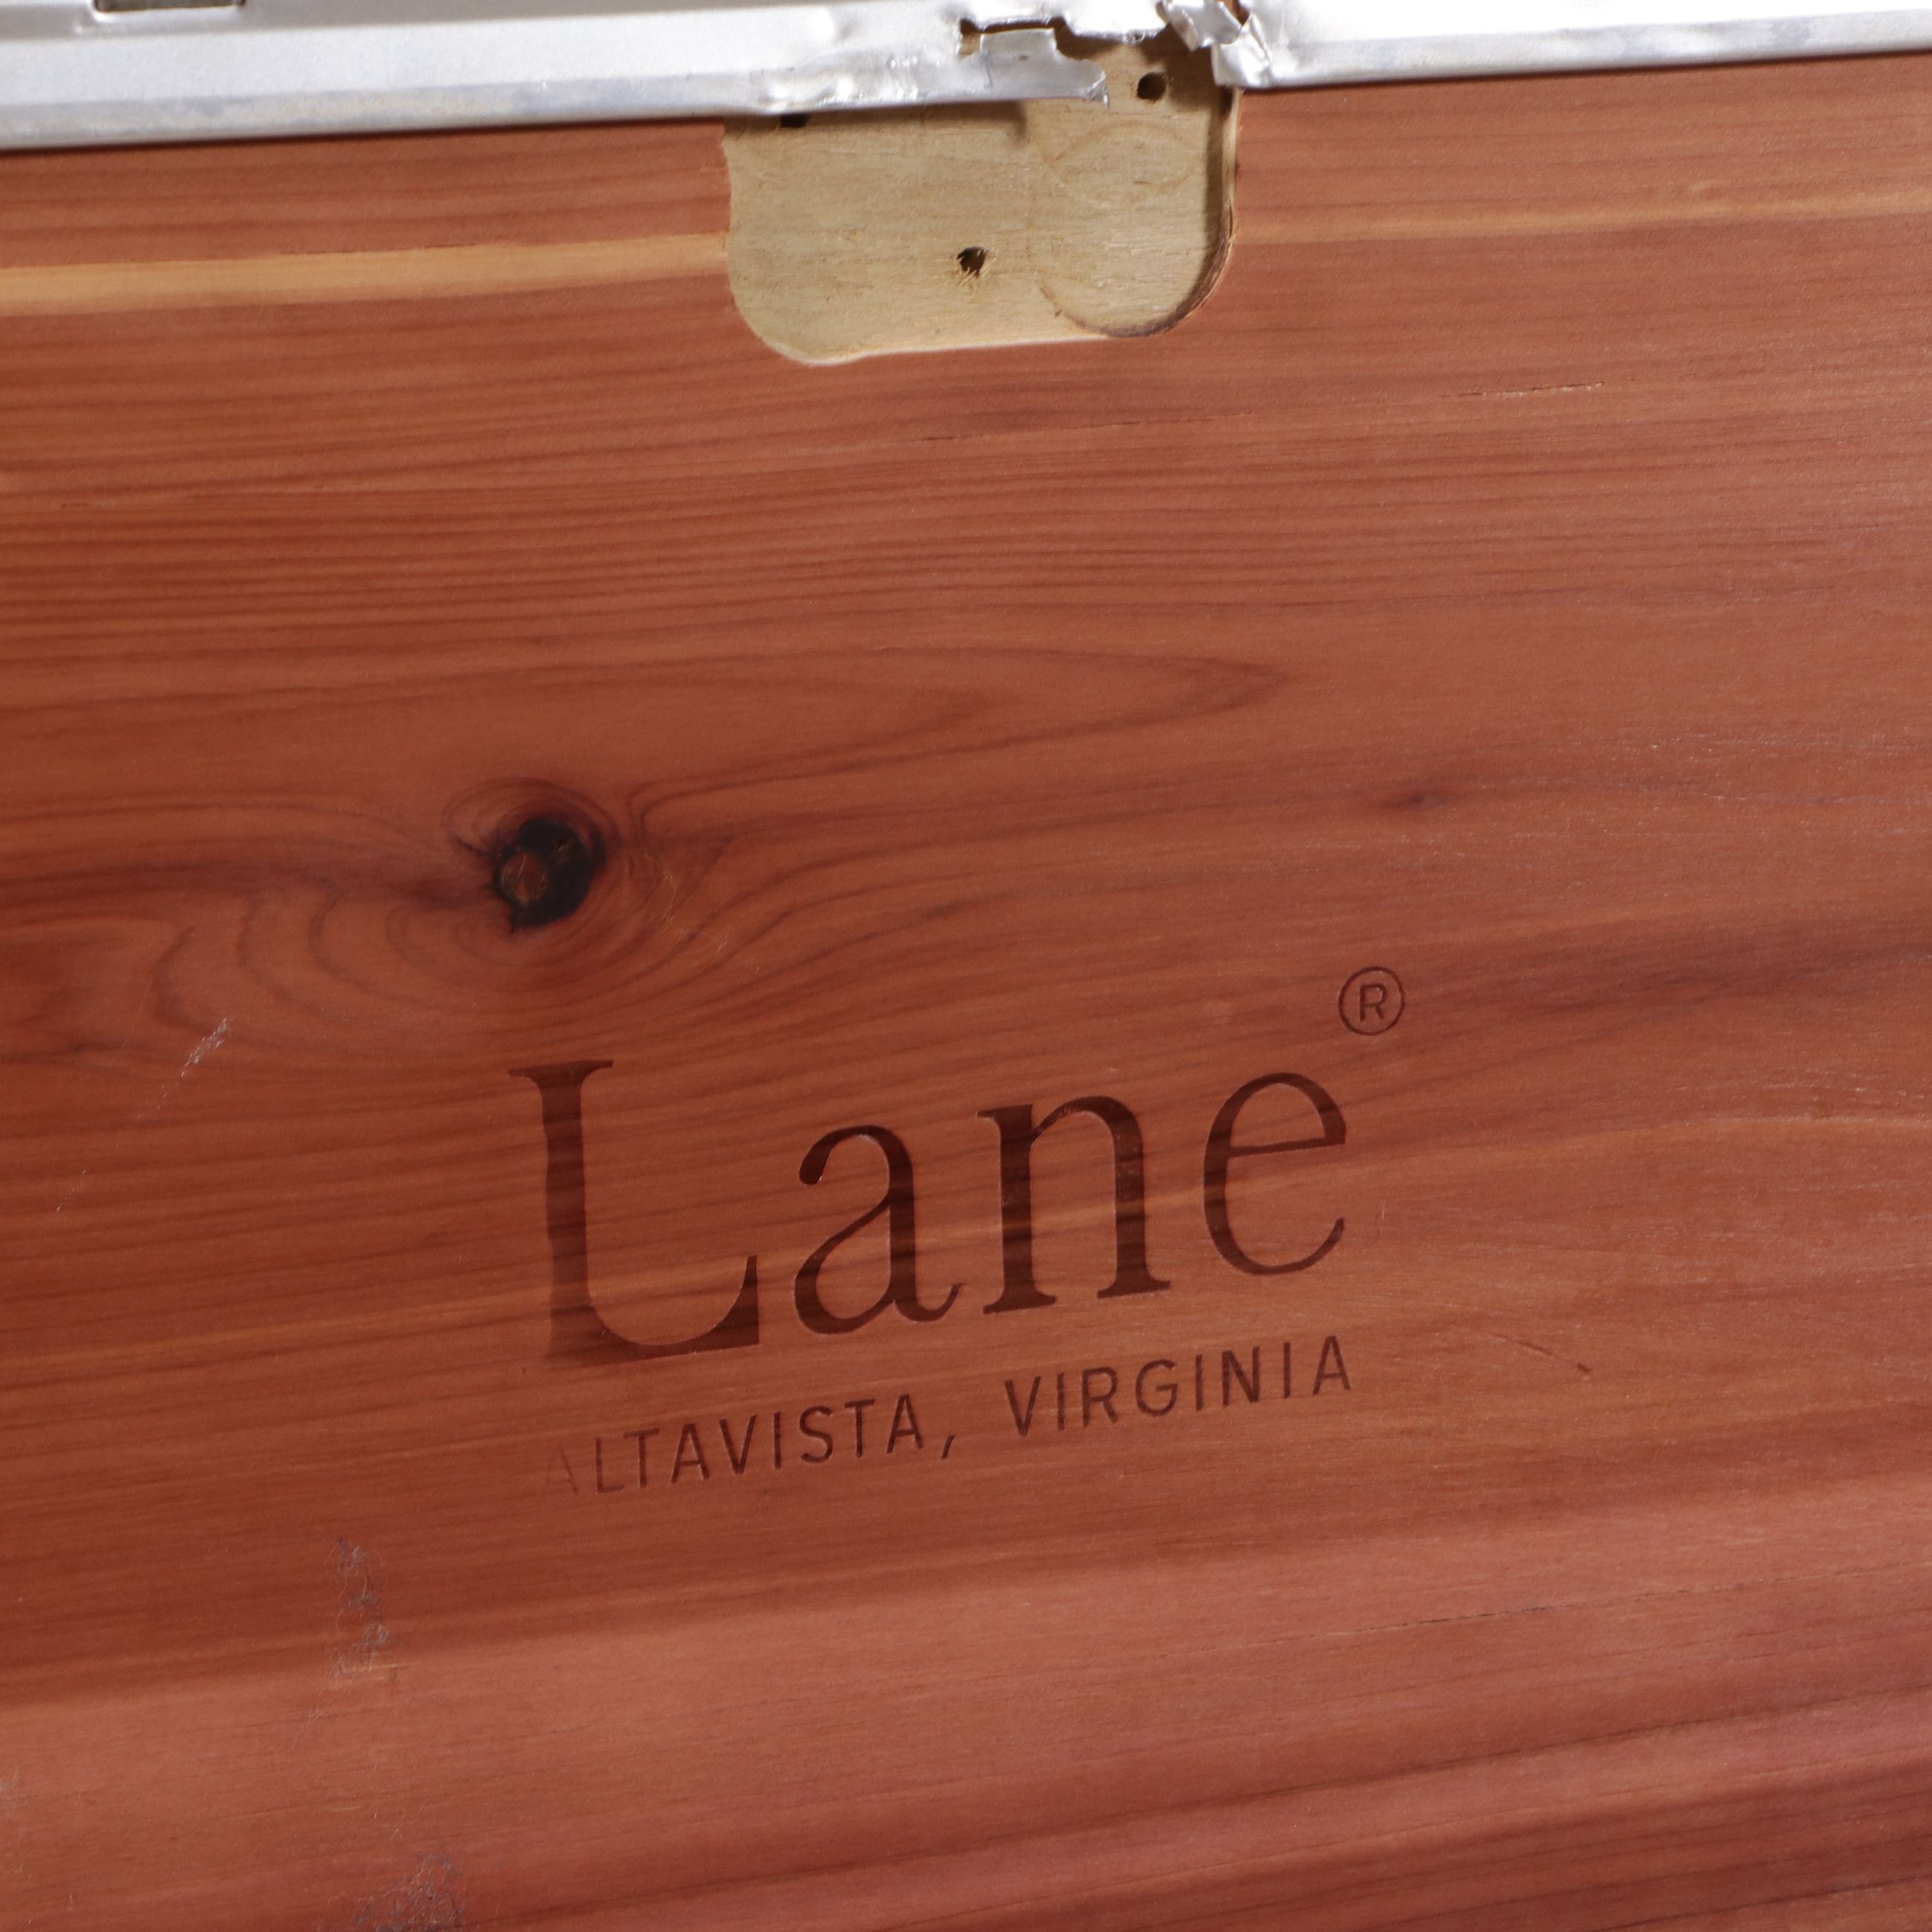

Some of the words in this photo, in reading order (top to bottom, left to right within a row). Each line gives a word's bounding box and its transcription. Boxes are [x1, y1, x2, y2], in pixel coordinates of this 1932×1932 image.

[509, 1060, 1349, 1367] Lane
[544, 1393, 956, 1497] ALTAVISTA,
[1004, 1335, 1352, 1437] VIRGINIA
